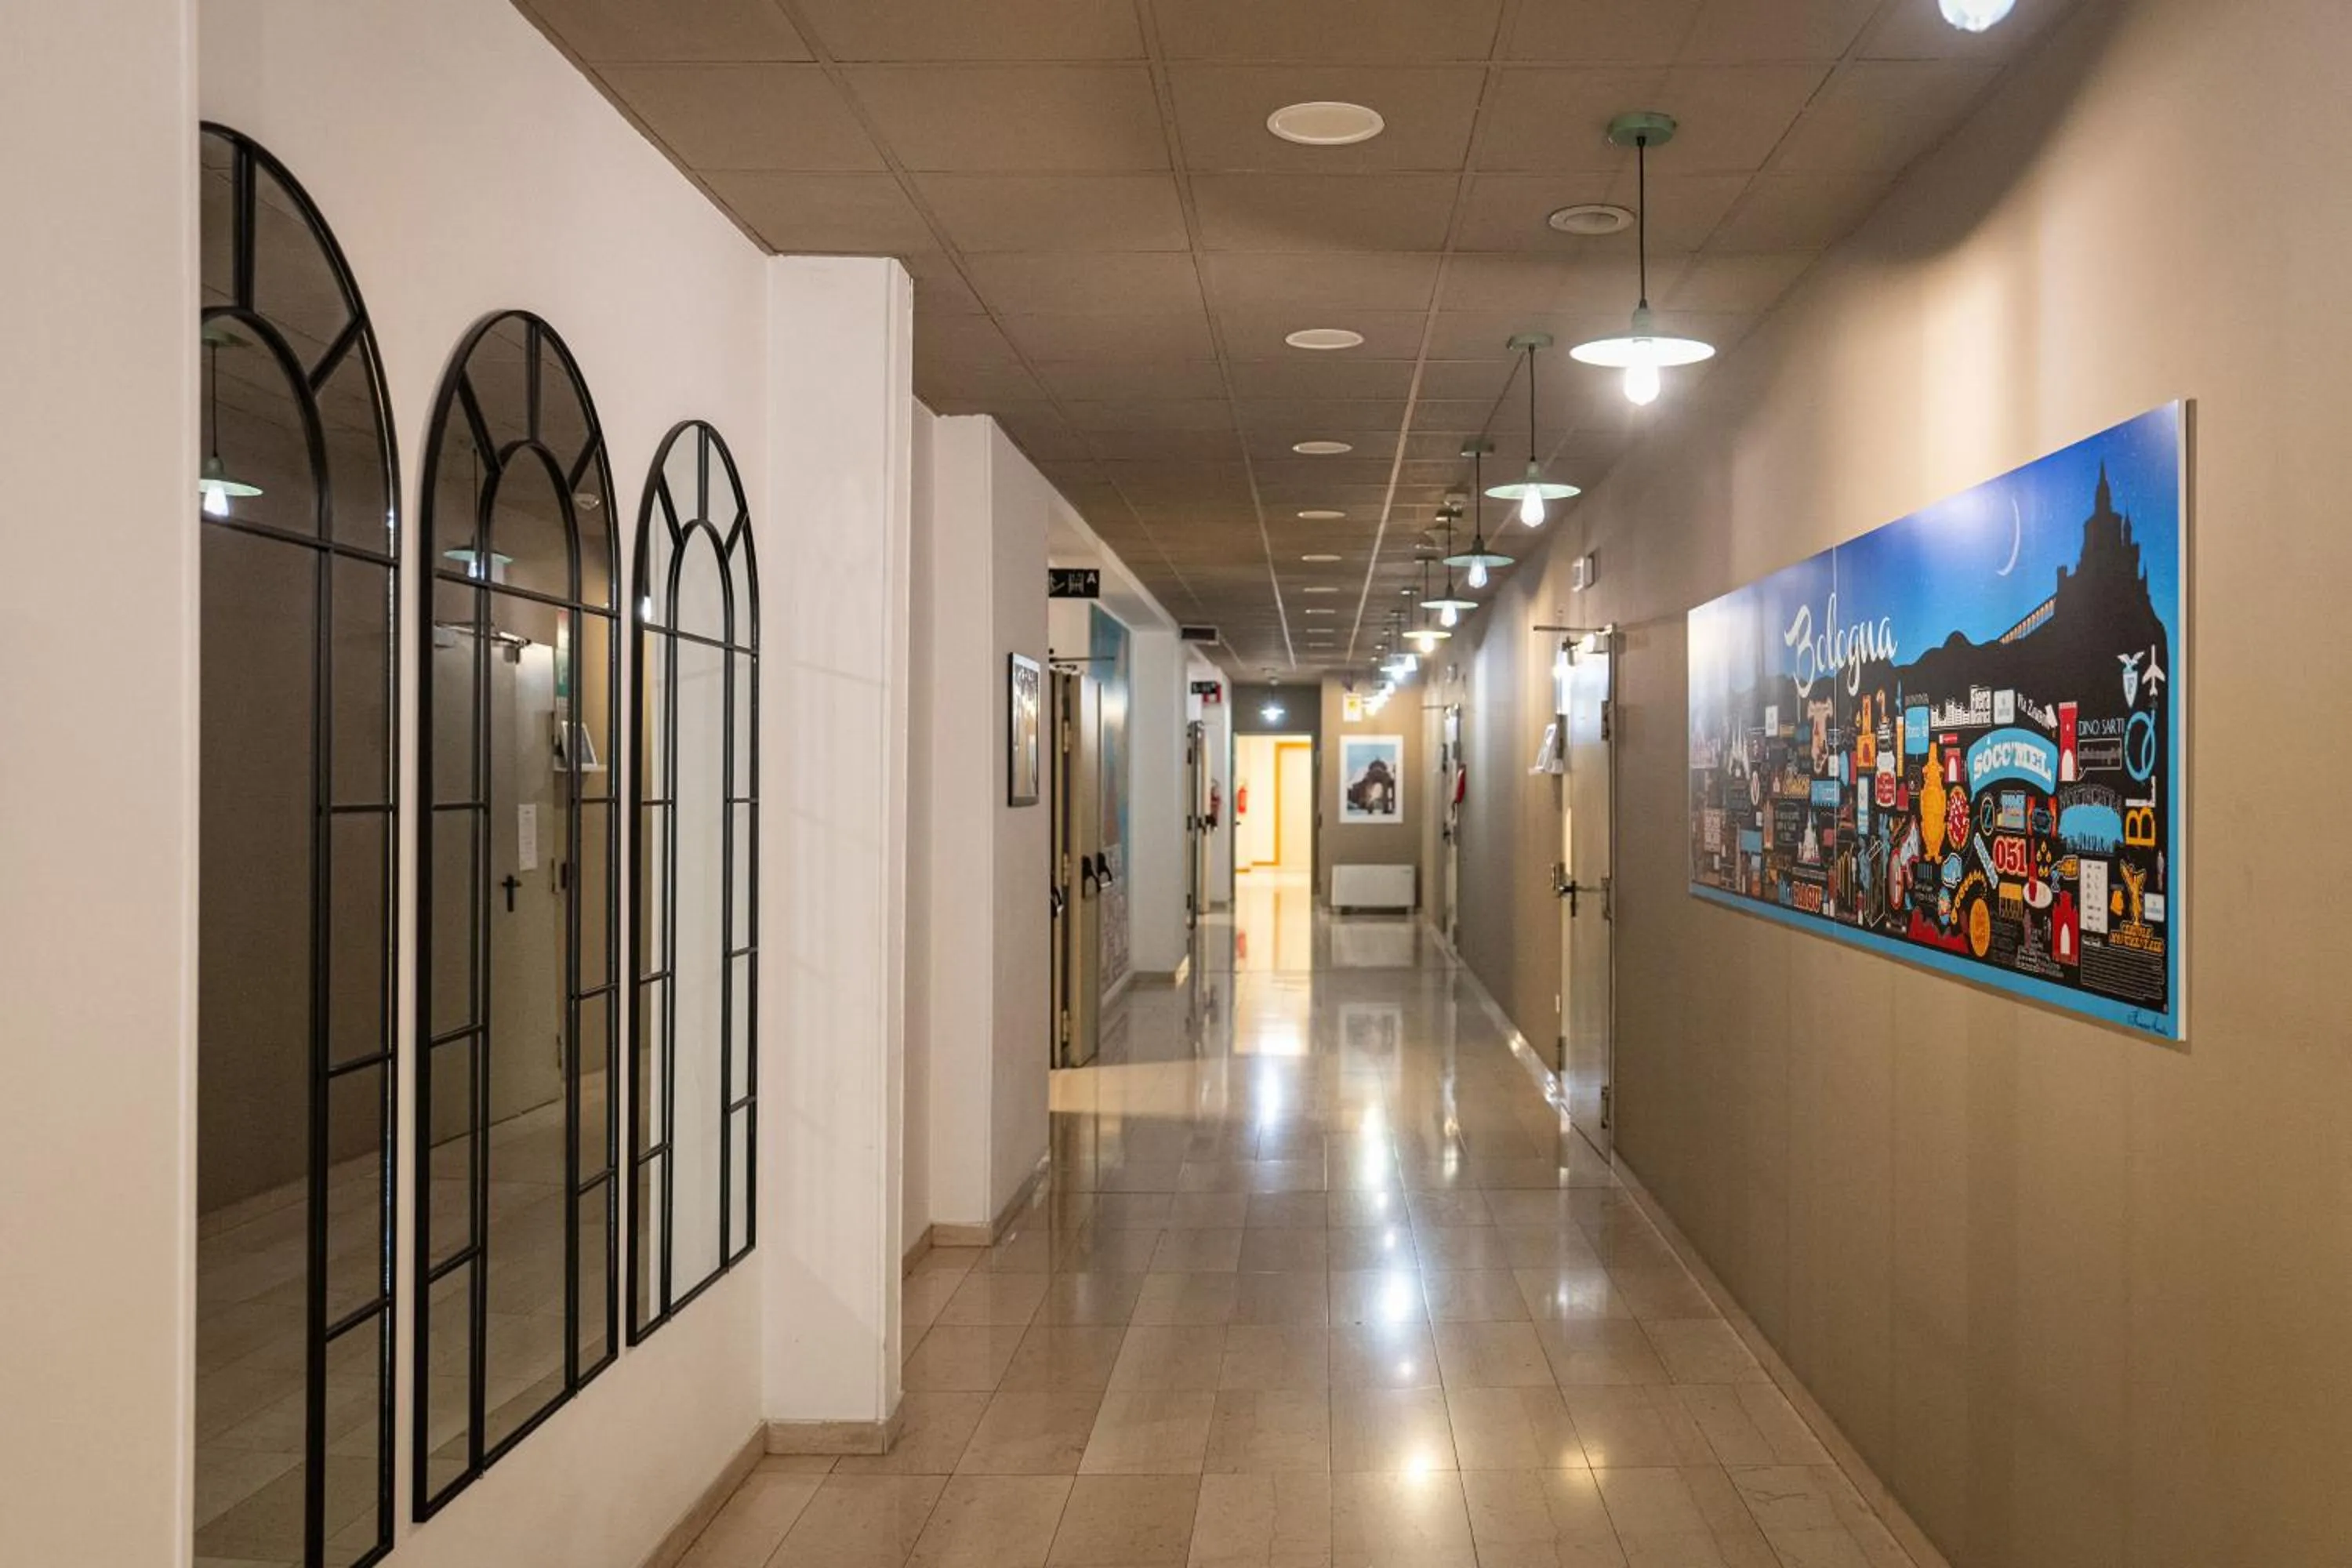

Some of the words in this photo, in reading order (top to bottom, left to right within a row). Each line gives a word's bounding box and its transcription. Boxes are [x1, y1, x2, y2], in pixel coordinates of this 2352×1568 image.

[1087, 572, 1097, 584] A
[1784, 592, 1898, 699] Bologna
[2078, 720, 2100, 735] DINO
[2102, 717, 2125, 735] SARTI
[1993, 835, 2028, 877] 051
